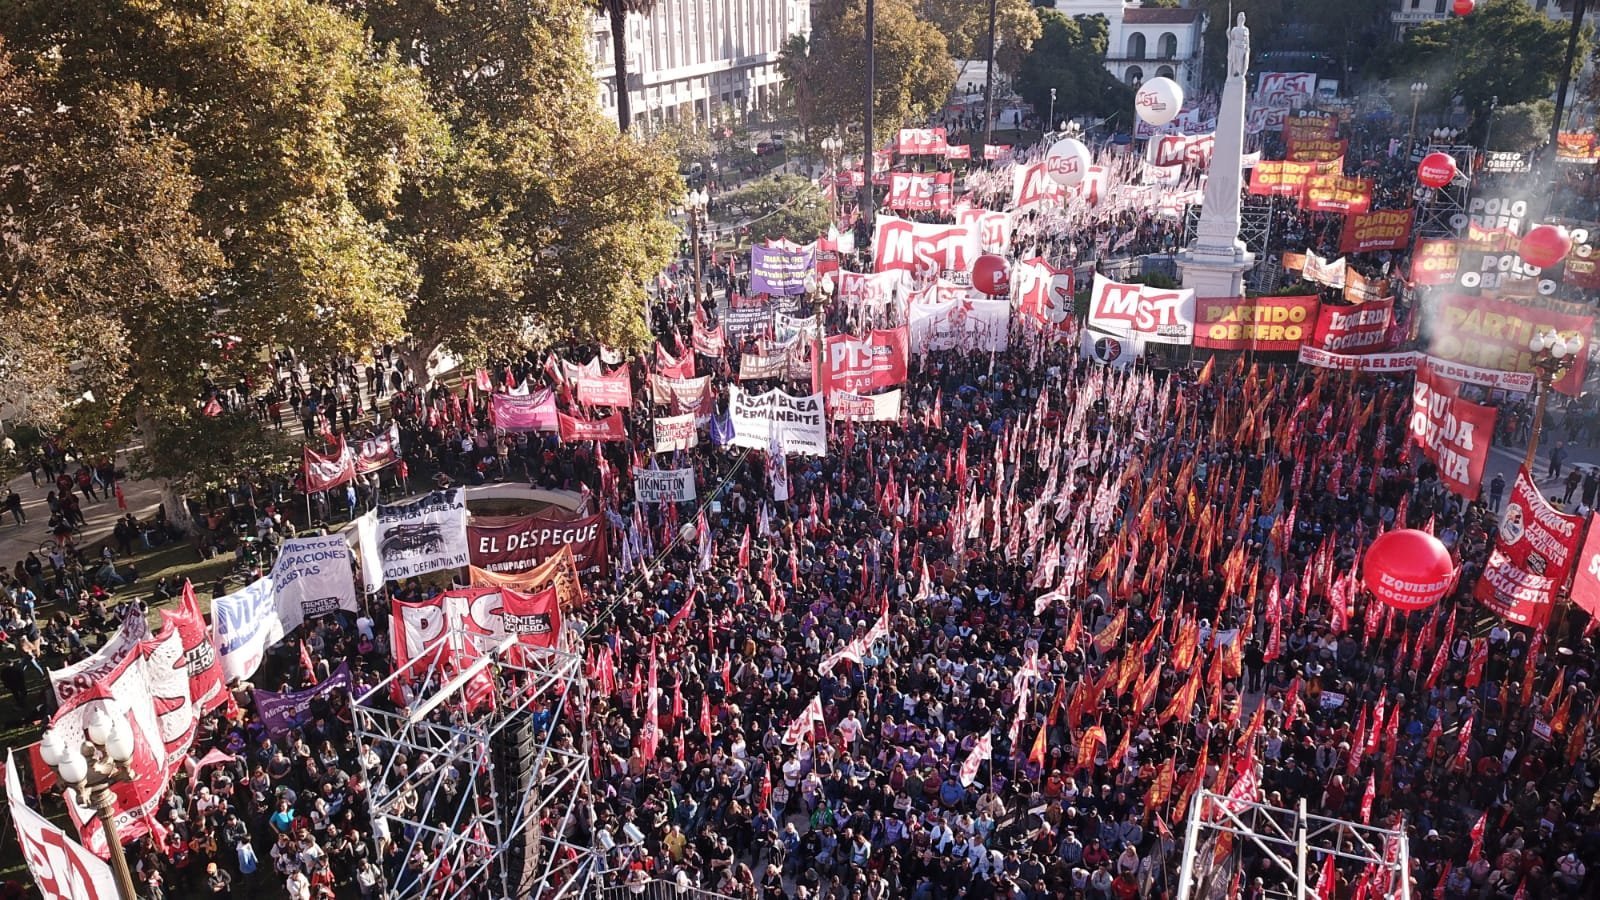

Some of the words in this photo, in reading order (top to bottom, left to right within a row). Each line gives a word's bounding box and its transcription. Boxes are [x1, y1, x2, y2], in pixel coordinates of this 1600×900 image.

[1262, 73, 1309, 93] MST
[899, 130, 931, 145] PTS
[1292, 141, 1341, 150] PARTIDO
[1159, 138, 1214, 168] MST
[1048, 156, 1077, 174] MST
[1258, 163, 1310, 173] PARTIDO
[1487, 160, 1525, 168] OBRERO
[893, 175, 935, 198] PTS
[1469, 197, 1527, 218] POLO
[1354, 212, 1408, 228] PARTIDO
[1354, 225, 1404, 240] OBRERO
[880, 222, 969, 278] MST
[1481, 256, 1542, 276] POLO
[1019, 260, 1069, 327] PTS
[1097, 285, 1180, 332] MST
[1206, 305, 1307, 323] PARTIDO
[1208, 325, 1302, 341] OBRERO
[1322, 329, 1386, 351] SOCIALISTA
[746, 356, 756, 367] LA
[831, 340, 873, 372] PTS
[1328, 356, 1371, 369] FUERA
[1373, 358, 1387, 368] EL
[1446, 366, 1471, 378] DEL
[736, 392, 818, 412] ASAMBLEA
[735, 406, 820, 426] PERMANENTE
[283, 541, 327, 555] MIENTO
[329, 537, 344, 547] DE
[479, 537, 500, 553] EL
[507, 523, 599, 552] DESPEGUE
[1529, 520, 1569, 559] IZQUIERDA
[278, 550, 346, 577] RUPACIONES
[413, 556, 454, 573] DEFINITIVA
[1489, 549, 1554, 589] ZQUIERDA
[1380, 573, 1449, 592] IZQUIERDA
[302, 599, 328, 609] FRENTE
[303, 603, 340, 615] IZQUIERDA
[402, 592, 505, 664] PTS
[129, 808, 143, 818] DE
